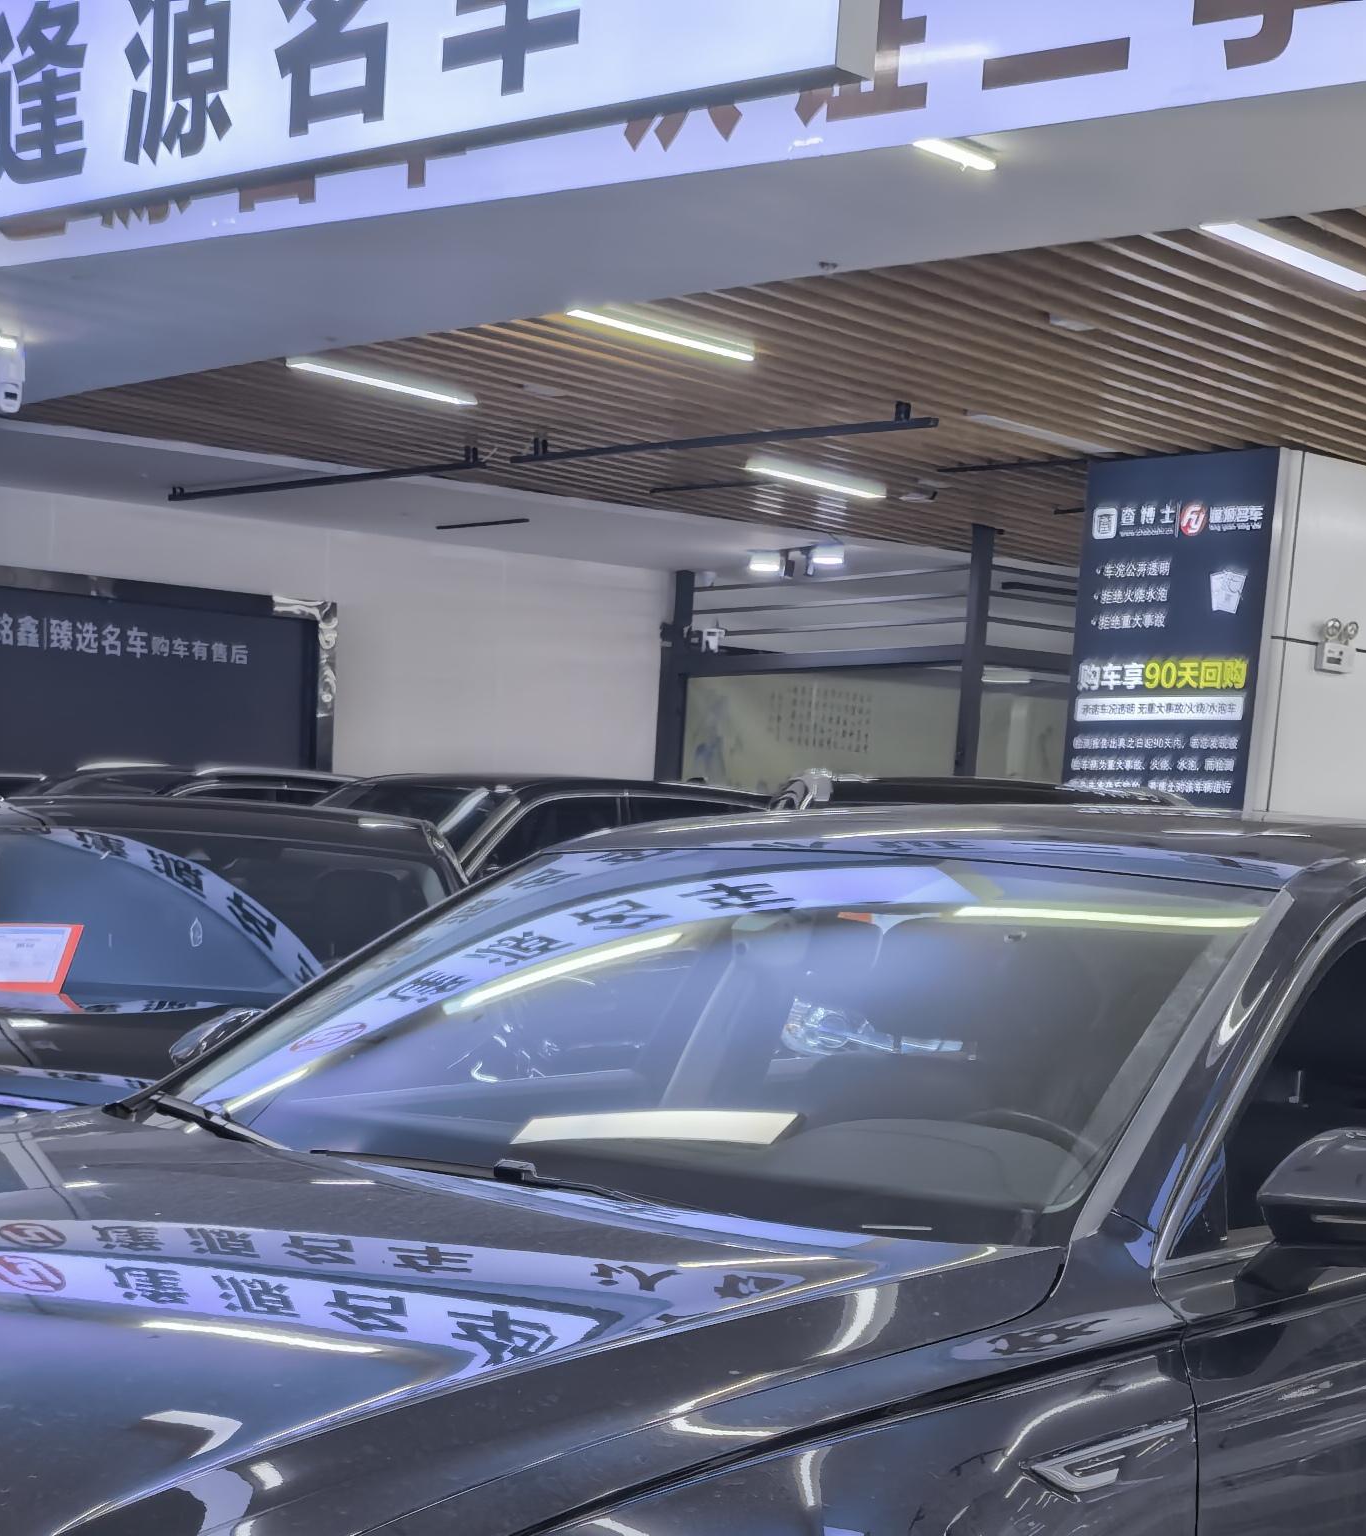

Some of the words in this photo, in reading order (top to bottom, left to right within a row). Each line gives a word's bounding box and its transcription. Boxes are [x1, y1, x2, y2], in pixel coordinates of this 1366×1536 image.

[1120, 502, 1176, 526] 查博士
[1077, 660, 1248, 691] 购车享90天回购
